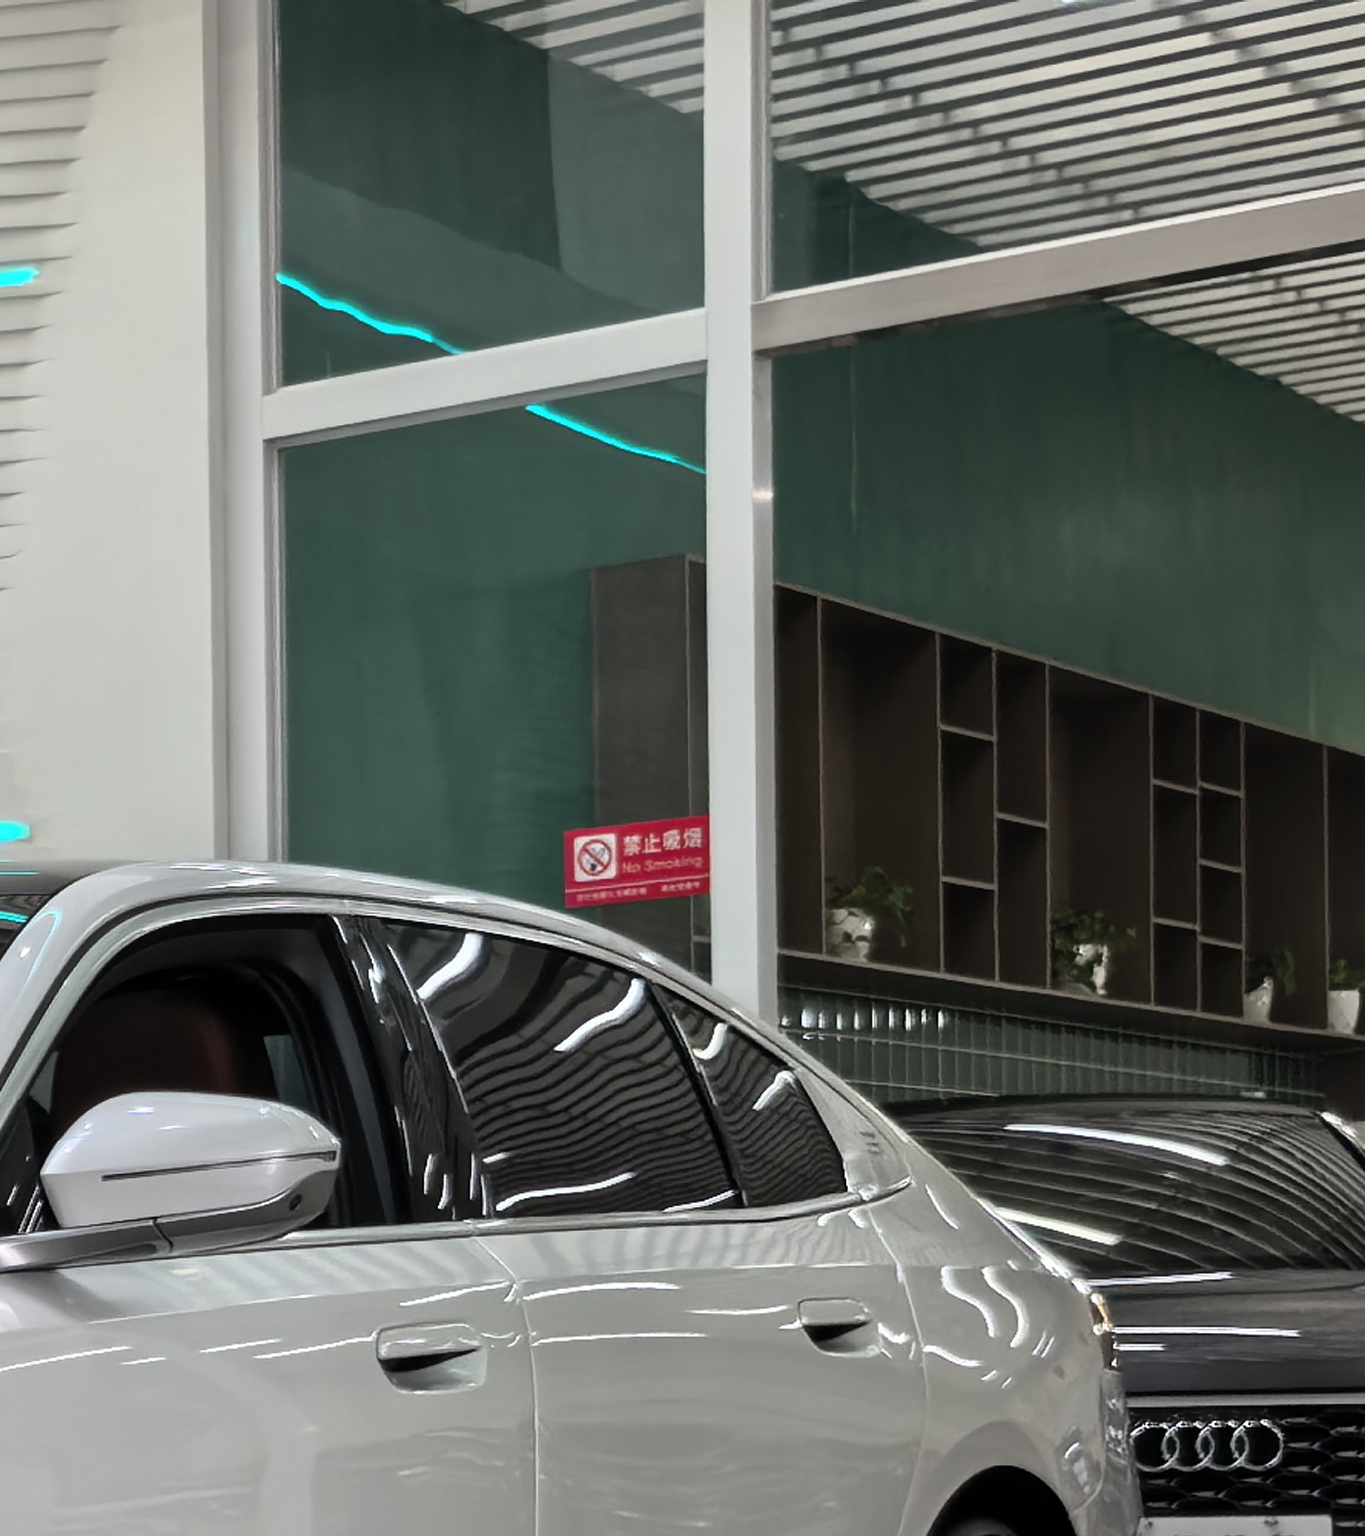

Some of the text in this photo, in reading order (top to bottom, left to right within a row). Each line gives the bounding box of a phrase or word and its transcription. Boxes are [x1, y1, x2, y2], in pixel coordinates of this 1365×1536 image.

[622, 828, 702, 856] 禁止吸烟
[623, 856, 703, 874] No Smoking
